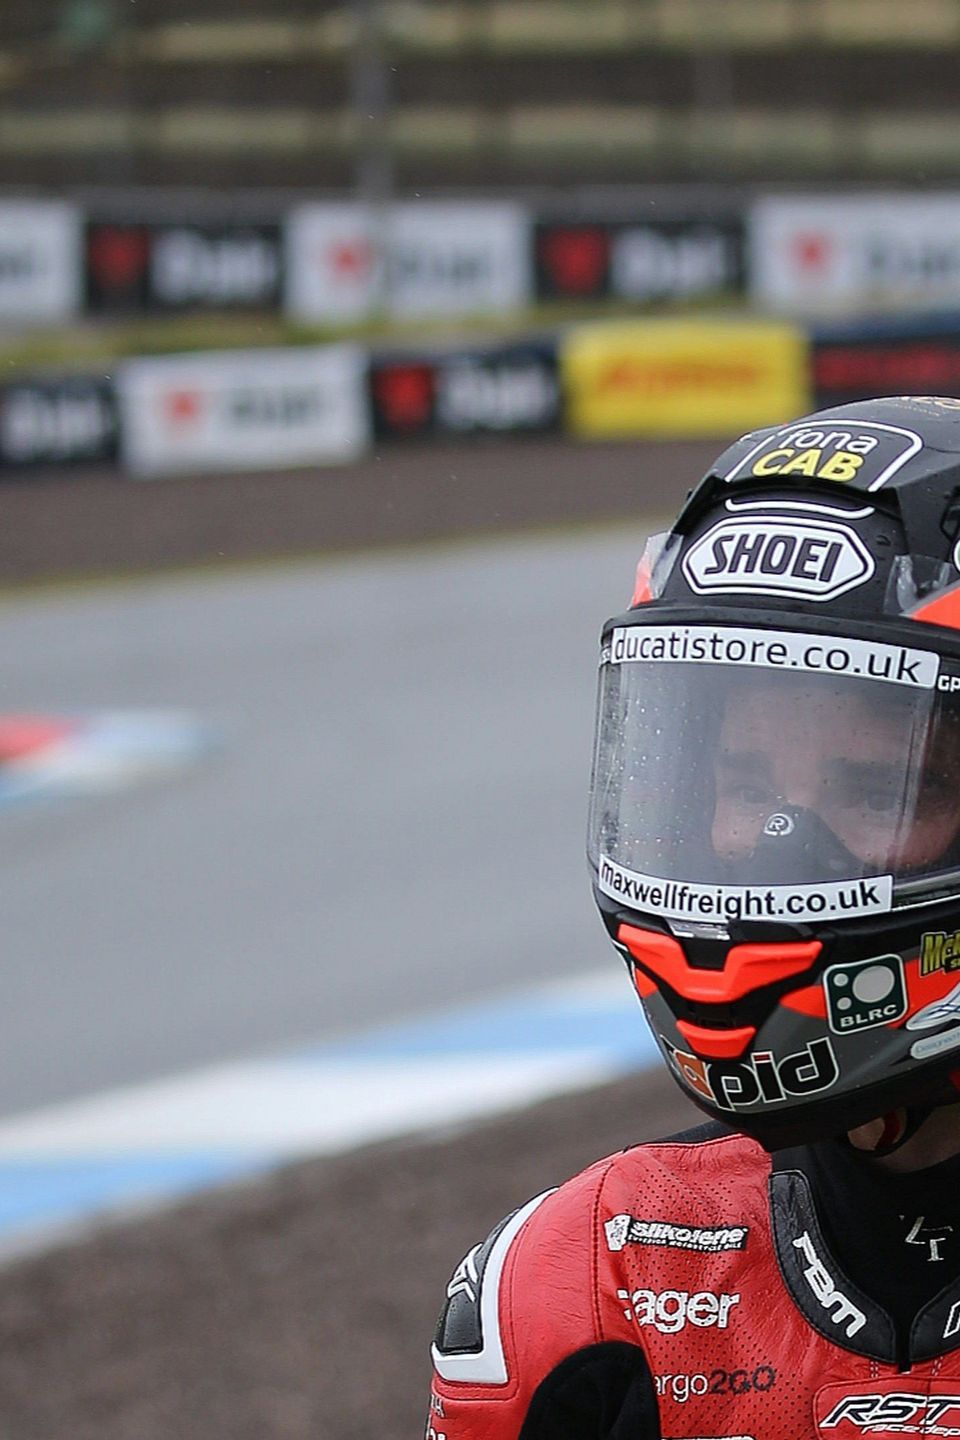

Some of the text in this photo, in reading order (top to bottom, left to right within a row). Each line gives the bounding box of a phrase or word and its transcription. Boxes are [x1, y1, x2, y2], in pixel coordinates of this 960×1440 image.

[752, 448, 864, 482] CAB
[704, 533, 843, 582] SHOEI
[614, 628, 922, 683] ducatistore.co.uk
[601, 861, 880, 919] maxwellfreight.co.uk
[840, 1004, 898, 1028] BLRC
[660, 1034, 840, 1111] apid
